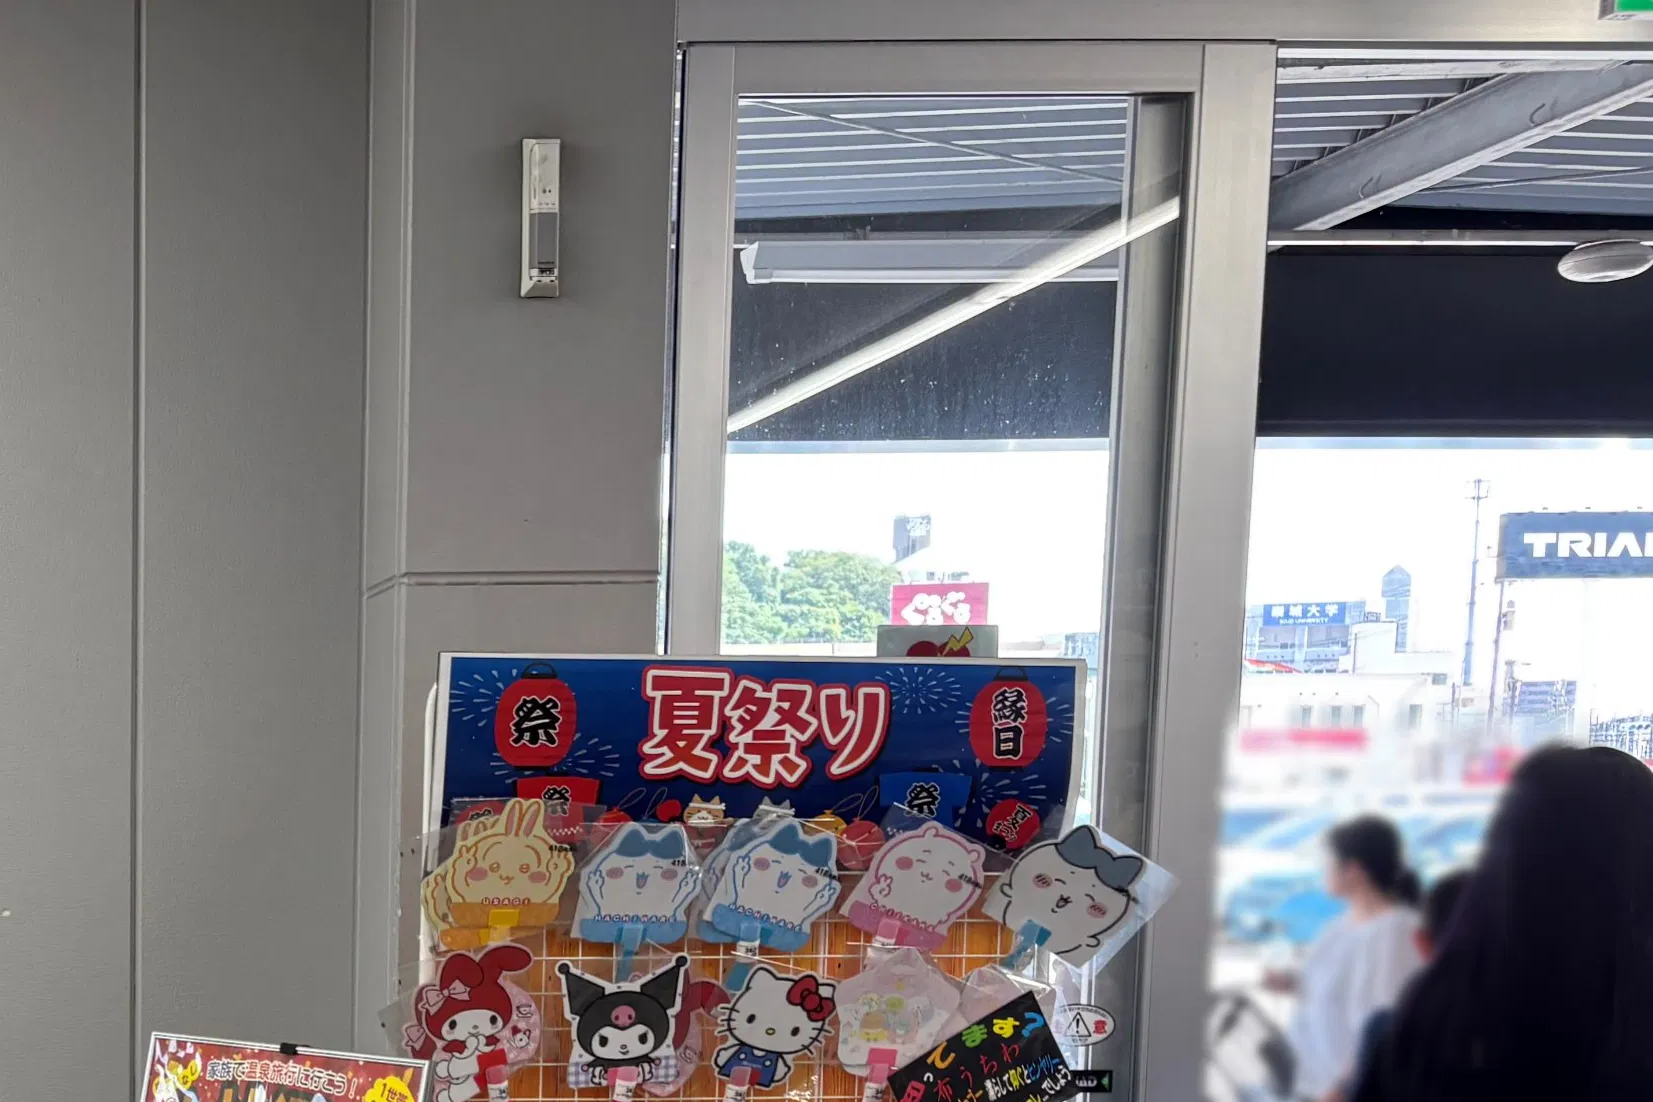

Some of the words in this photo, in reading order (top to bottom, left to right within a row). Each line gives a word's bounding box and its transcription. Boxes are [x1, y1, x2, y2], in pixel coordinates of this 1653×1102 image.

[509, 696, 562, 748] 祭
[640, 667, 889, 787] 夏祭り
[991, 687, 1029, 760] 縁日
[906, 782, 941, 818] 祭
[207, 1060, 358, 1099] 家族で温泉旅行に行こう！
